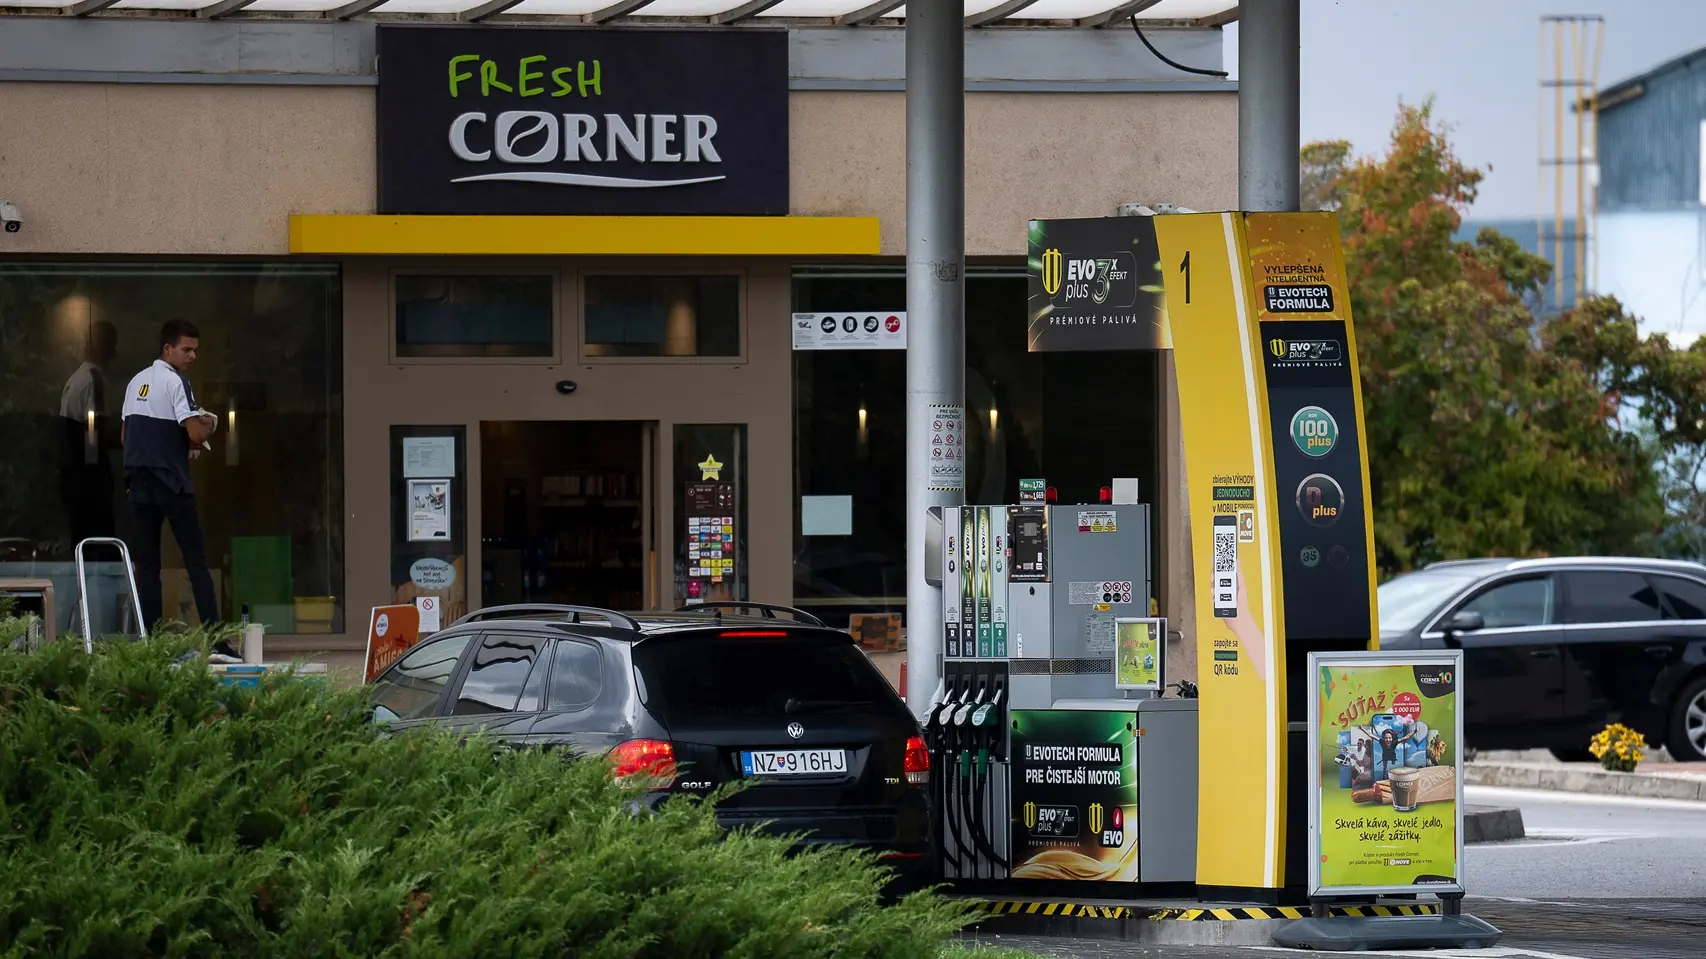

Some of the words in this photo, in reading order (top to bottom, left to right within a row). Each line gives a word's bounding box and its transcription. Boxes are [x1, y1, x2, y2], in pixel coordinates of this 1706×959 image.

[449, 54, 602, 98] FRESH
[449, 110, 722, 163] CORNER
[1263, 263, 1325, 274] VYLEPŠENÁ
[1067, 259, 1095, 281] EVO
[1092, 258, 1111, 304] 3
[1109, 271, 1128, 280] EFEKT
[1179, 250, 1191, 304] 1
[1265, 274, 1326, 283] INTELIGENTNÁ
[1065, 279, 1089, 302] plus
[1278, 287, 1328, 297] EVOTECH
[1269, 298, 1330, 309] FORMULA
[1049, 313, 1097, 325] PRÉMIOVÉ
[1102, 313, 1137, 324] PALIVÁ
[1289, 342, 1311, 351] EVO
[1289, 350, 1307, 360] plus
[1299, 419, 1328, 437] 100
[1307, 436, 1332, 449] plus
[1212, 475, 1232, 486] zbierajte
[1232, 473, 1254, 484] VÝHODY
[1216, 488, 1250, 498] JEDNODUCHO
[1306, 486, 1322, 507] D
[1212, 505, 1217, 513] v
[1217, 503, 1238, 513] MOBILE
[1312, 504, 1337, 519] plus
[1214, 638, 1231, 649] zapojte
[1214, 663, 1223, 676] QR
[1224, 663, 1239, 675] kódu
[1439, 671, 1453, 684] 10
[1338, 690, 1387, 728] SÚŤAŽ
[1033, 746, 1075, 761] EVOTECH
[1077, 747, 1120, 762] FORMULA
[754, 753, 778, 772] NZ
[786, 751, 844, 771] 916HJ
[1025, 768, 1044, 783] PRE
[1046, 765, 1086, 784] ČISTEJŠÍ
[1088, 770, 1121, 785] MOTOR
[1420, 768, 1455, 790] ORNER
[681, 781, 711, 789] GOLF
[1038, 808, 1056, 821] EVO
[1037, 820, 1052, 834] plus
[1335, 817, 1364, 830] Skvelá
[1366, 817, 1390, 829] káva,
[1393, 816, 1418, 828] skvelé
[1421, 816, 1443, 829] jedlo,
[1102, 830, 1122, 845] EVO
[1359, 830, 1385, 841] skvelé
[1388, 830, 1421, 843] zážitky.
